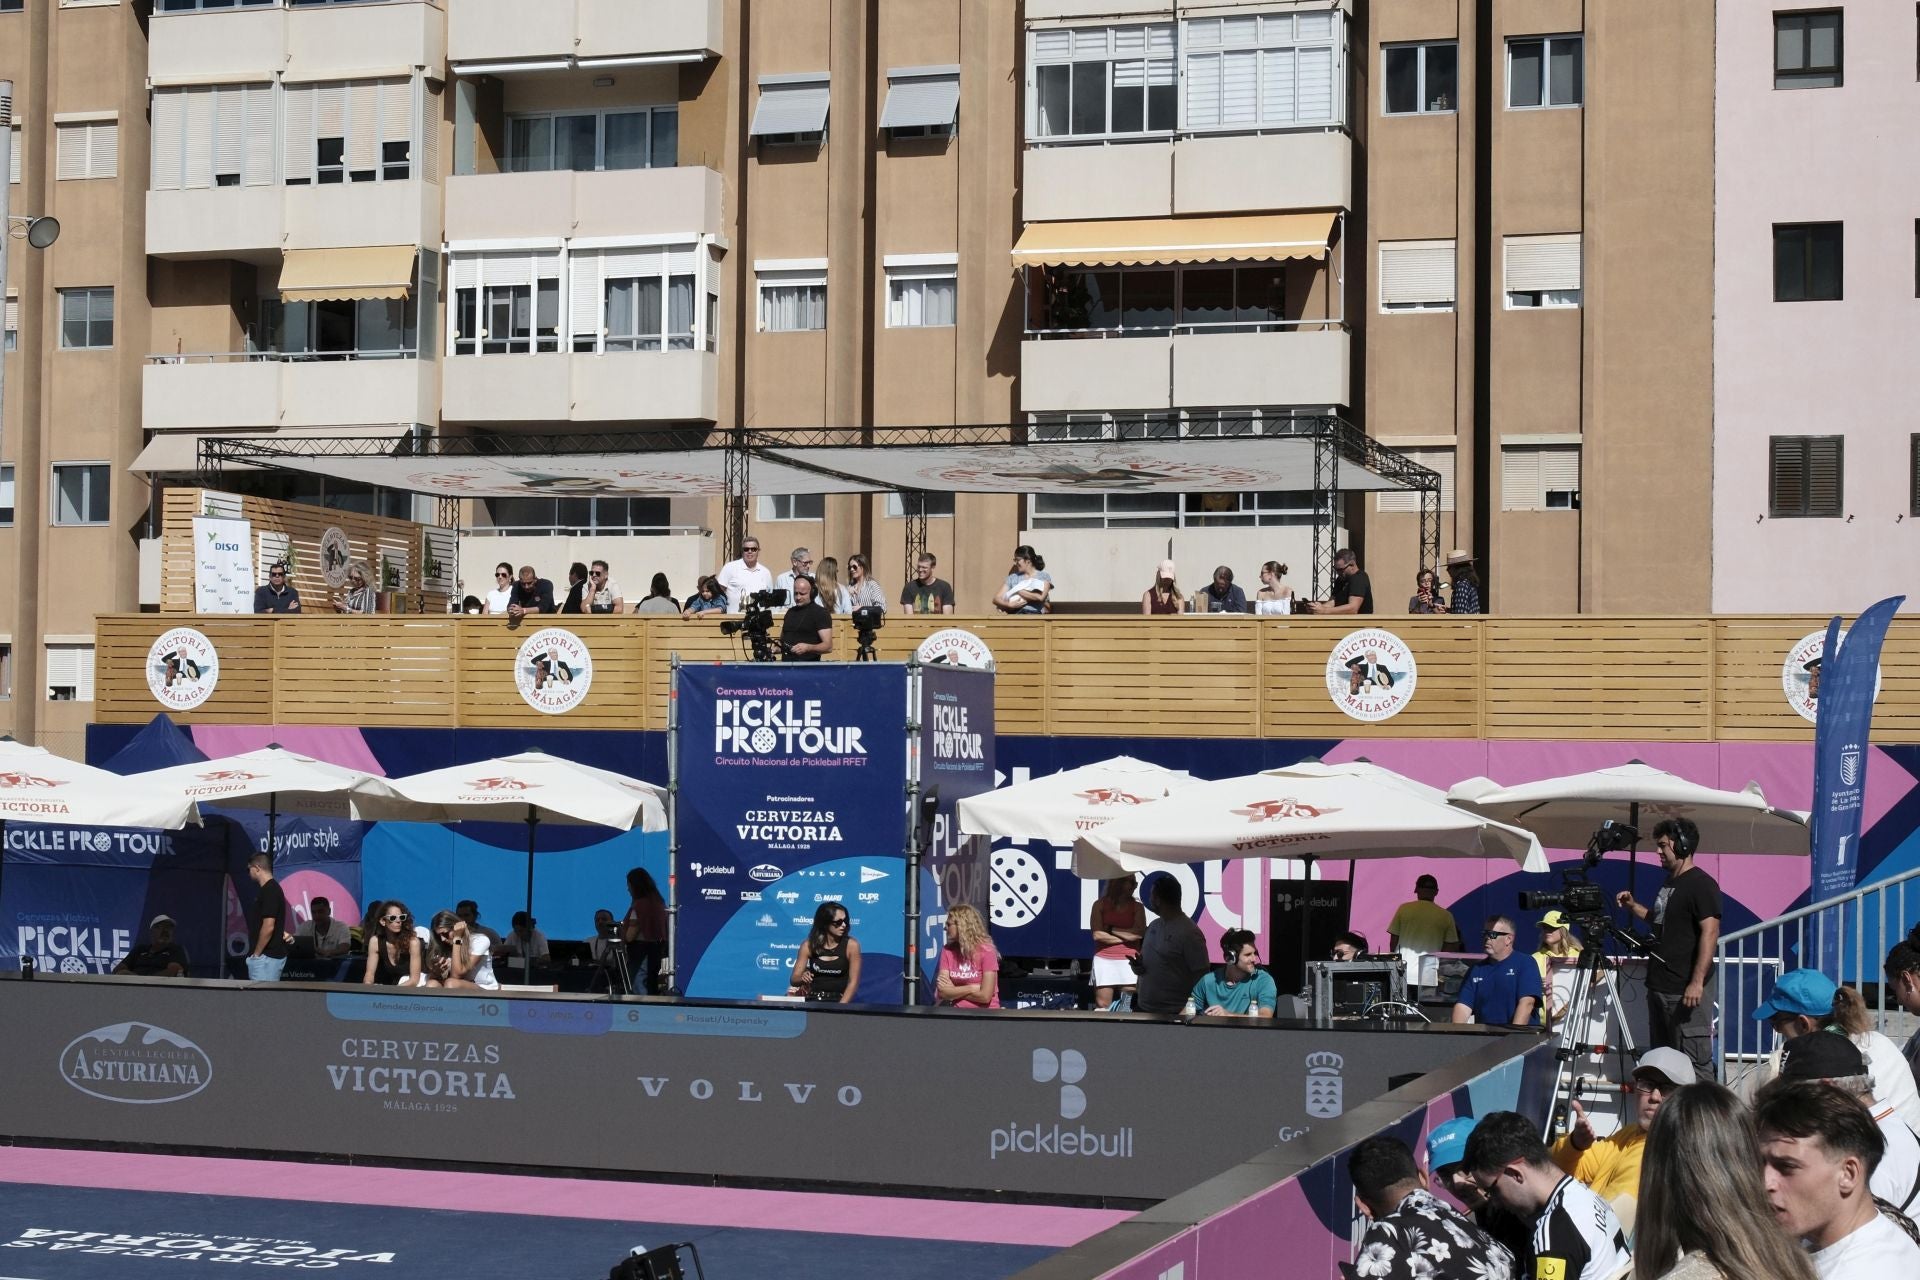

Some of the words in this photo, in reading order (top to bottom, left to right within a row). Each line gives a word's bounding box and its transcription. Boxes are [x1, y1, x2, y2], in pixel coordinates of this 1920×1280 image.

[158, 636, 206, 656] VICTORIA
[526, 637, 578, 658] VICTORIA
[924, 638, 980, 660] VICTORIA
[1340, 638, 1401, 662] VICTORIA
[162, 686, 205, 702] MÁLAGA
[531, 689, 577, 706] MÁLAGA
[716, 687, 756, 696] Cervezas
[758, 688, 794, 696] Victoria
[1345, 694, 1400, 712] MÁLAGA
[716, 700, 822, 726] PICKLE
[934, 704, 968, 732] PICKLE
[715, 757, 750, 766] Circuito
[752, 758, 788, 766] Nacional
[790, 758, 800, 766] de
[802, 758, 841, 766] Pickleball
[843, 758, 868, 766] RFET
[184, 784, 246, 796] VICTORIA
[2, 802, 70, 813] ICTORIA
[746, 810, 834, 822] CERVEZAS
[4, 830, 64, 850] ICKLE
[286, 833, 314, 855] your
[314, 826, 340, 852] style
[736, 825, 843, 840] VICTORIA
[1232, 834, 1332, 851] VICTORIA
[704, 866, 734, 875] picklebull
[932, 864, 982, 907] YOUR
[858, 892, 879, 900] DUPR
[16, 912, 61, 922] Cervezas
[64, 912, 100, 922] Victoria
[18, 926, 130, 958] PICKLE
[478, 1004, 499, 1016] 10
[527, 1008, 537, 1018] 0
[628, 1010, 640, 1022] 6
[342, 1038, 500, 1064] CERVEZAS
[72, 1048, 200, 1084] ASTURIANA
[326, 1065, 516, 1099] VICTORIA
[637, 1076, 863, 1106] VOLVO
[384, 1099, 430, 1111] MÁLAGA
[435, 1103, 458, 1112] 1928
[990, 1122, 1133, 1160] picklebull
[0, 1240, 340, 1268] CERVEZAS
[19, 1228, 396, 1263] VICTORIA
